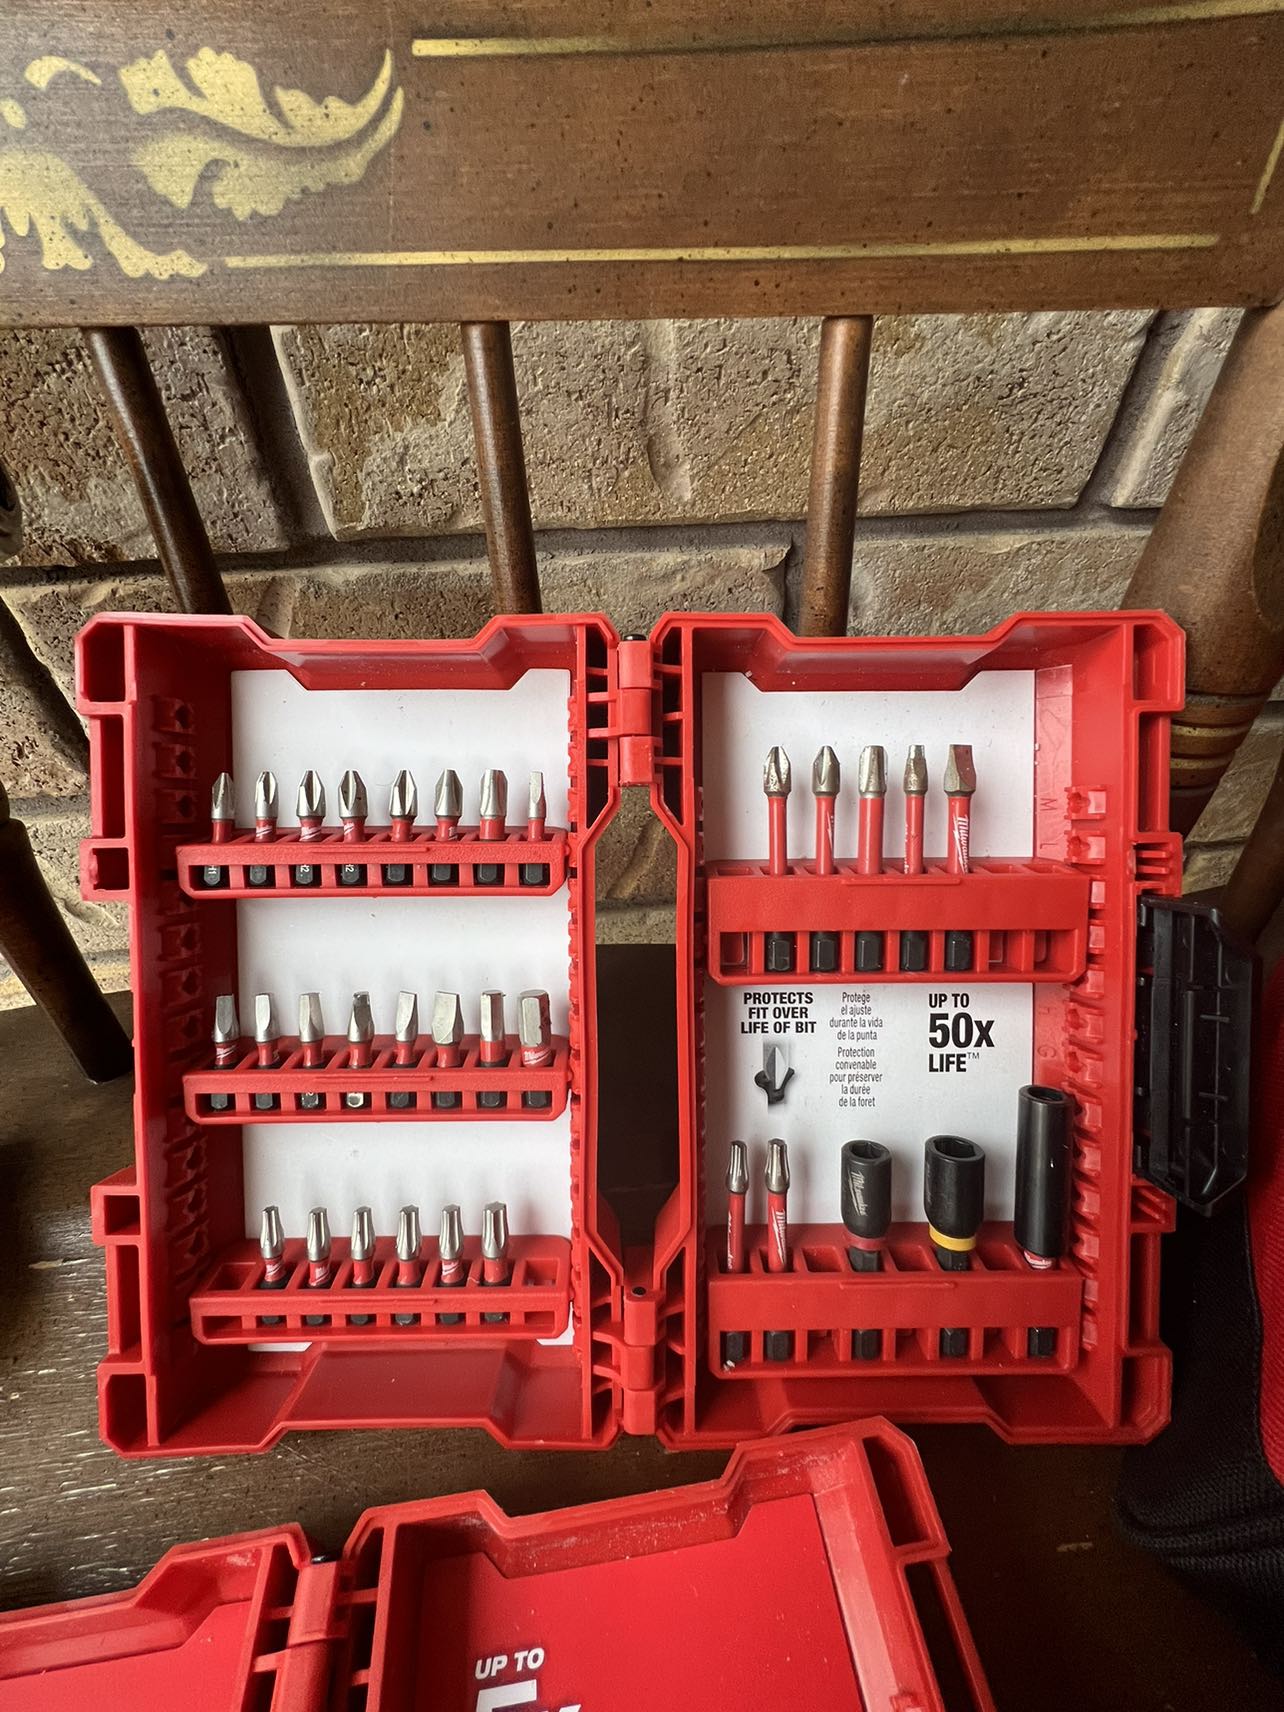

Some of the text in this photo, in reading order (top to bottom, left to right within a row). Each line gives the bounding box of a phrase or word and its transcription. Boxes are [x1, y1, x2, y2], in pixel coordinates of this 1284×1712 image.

[743, 991, 814, 1005] PROTECTS
[928, 993, 970, 1008] UP TO
[748, 1006, 809, 1019] FIT OVER
[840, 1004, 872, 1017] el ajuste
[741, 1021, 817, 1034] LIFE OF BIT
[829, 1016, 884, 1028] durante la vida
[837, 1029, 878, 1043] de la punta
[837, 1046, 875, 1058] Protection
[835, 1059, 877, 1070] convenable
[829, 1070, 883, 1085] pour préserver
[841, 1083, 871, 1095] la durée
[838, 1096, 876, 1108] de la foret
[474, 1647, 545, 1680] UP TO
